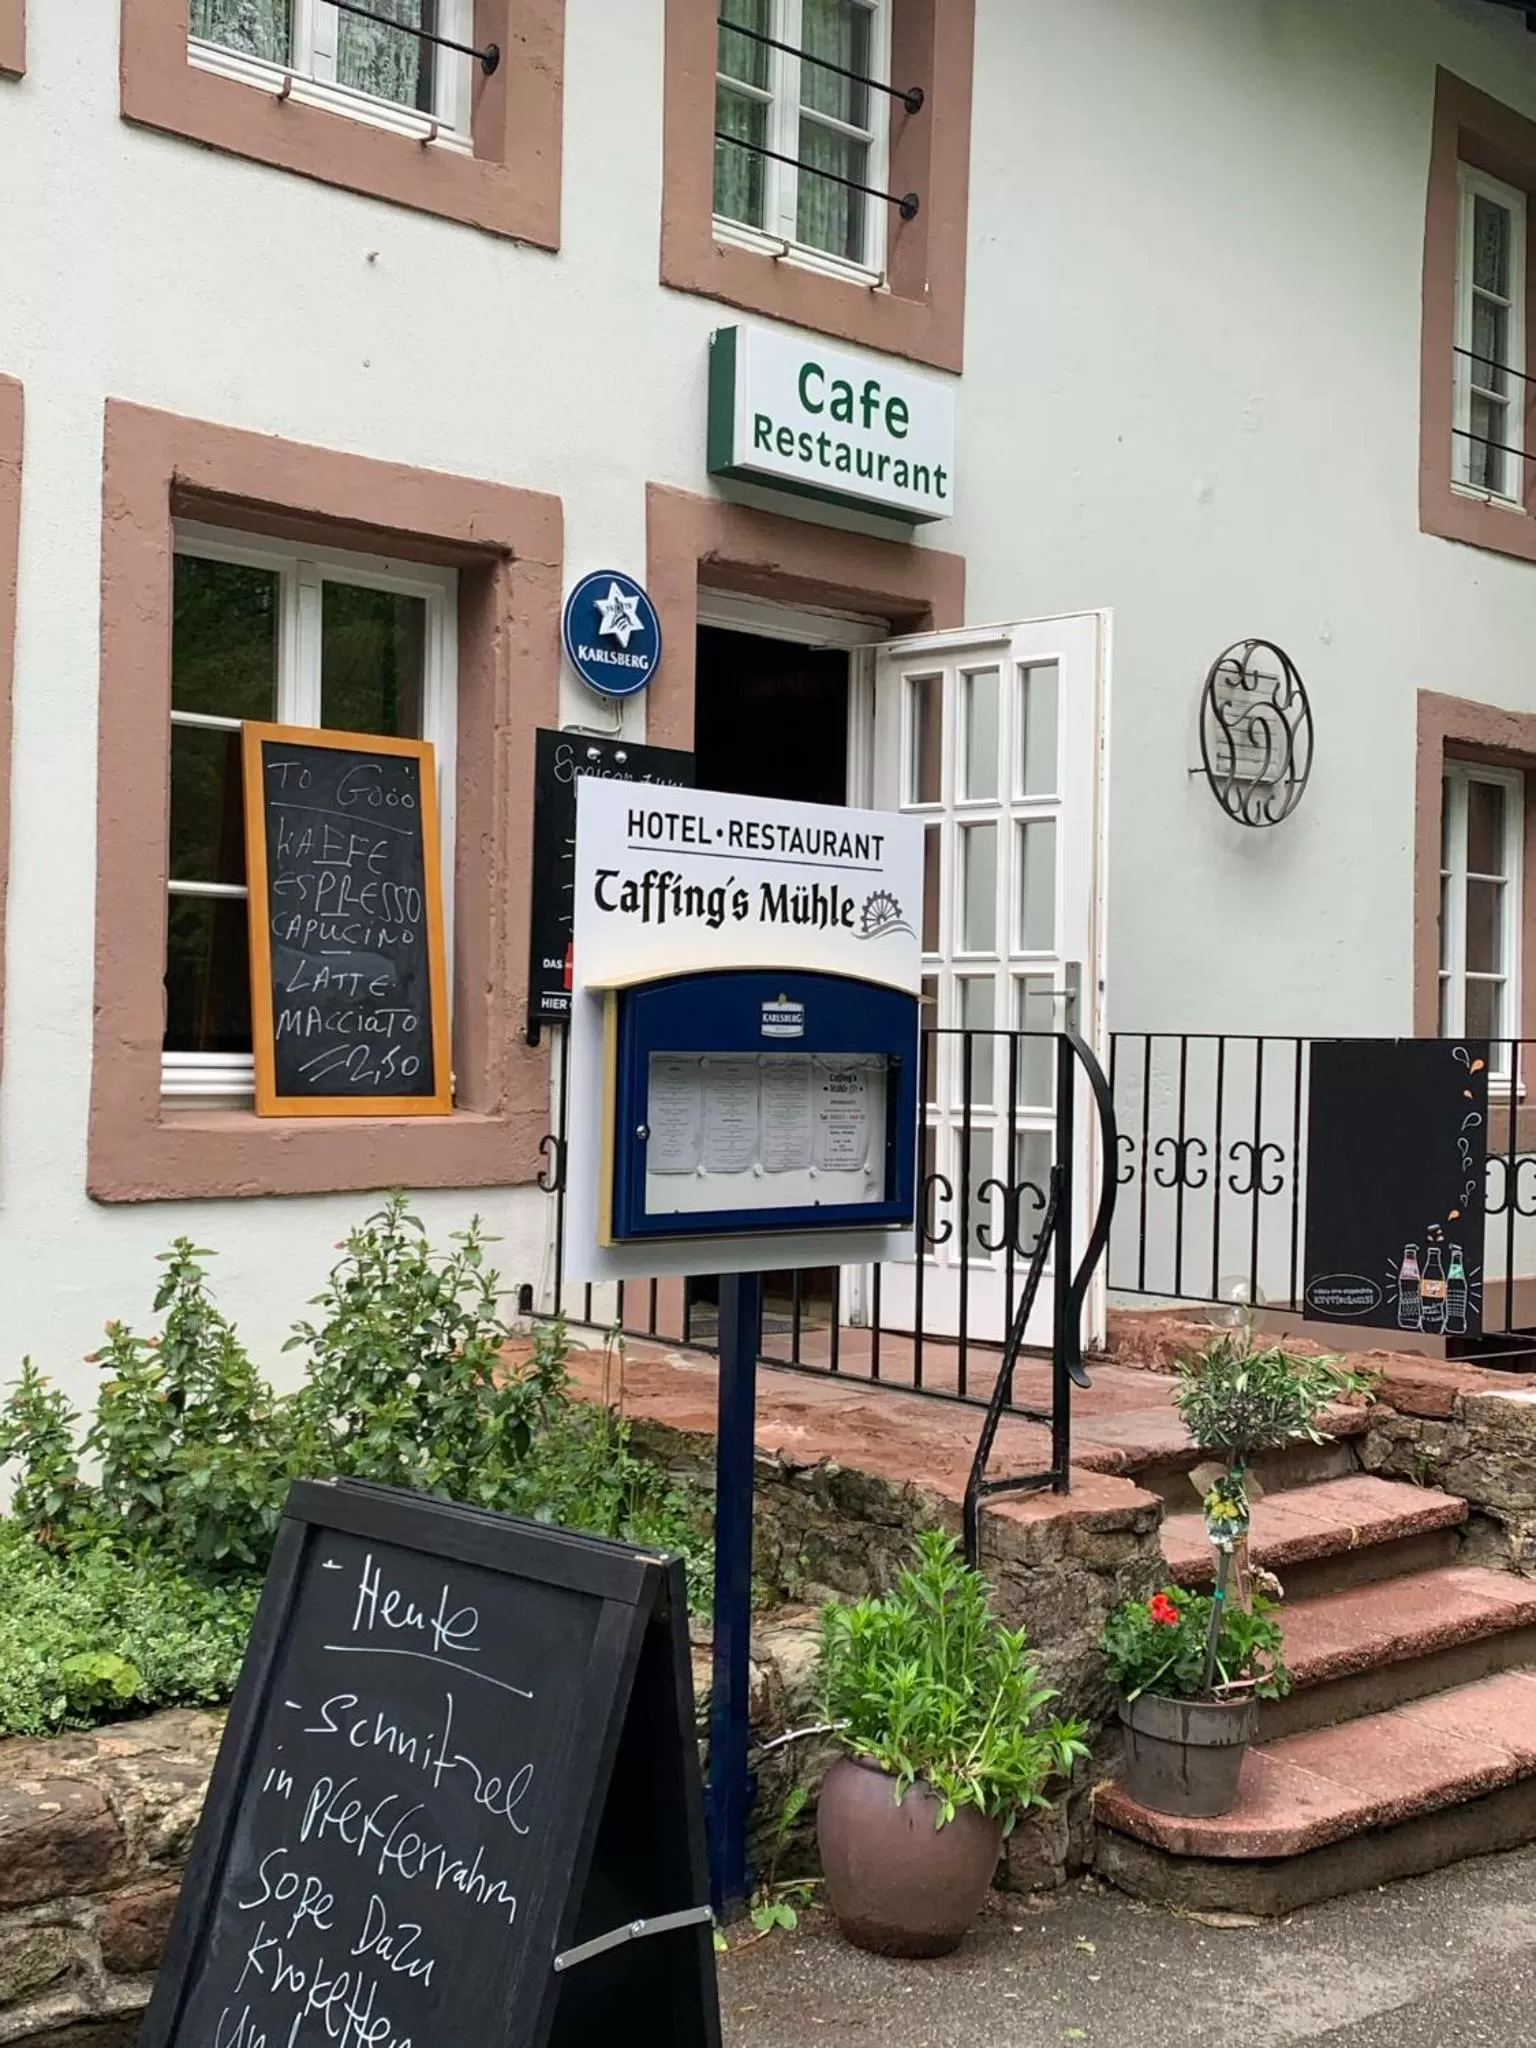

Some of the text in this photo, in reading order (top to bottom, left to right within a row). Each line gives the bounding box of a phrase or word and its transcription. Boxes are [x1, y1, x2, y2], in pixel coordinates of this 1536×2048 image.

[797, 361, 910, 439] Cafe
[753, 412, 948, 500] Restaurant
[578, 644, 649, 671] KARLSBERG
[759, 881, 856, 930] Mühle
[542, 957, 563, 970] DAS
[541, 996, 568, 1010] HIER
[762, 1012, 803, 1024] KARLSBERG
[352, 1553, 481, 1653] Heute
